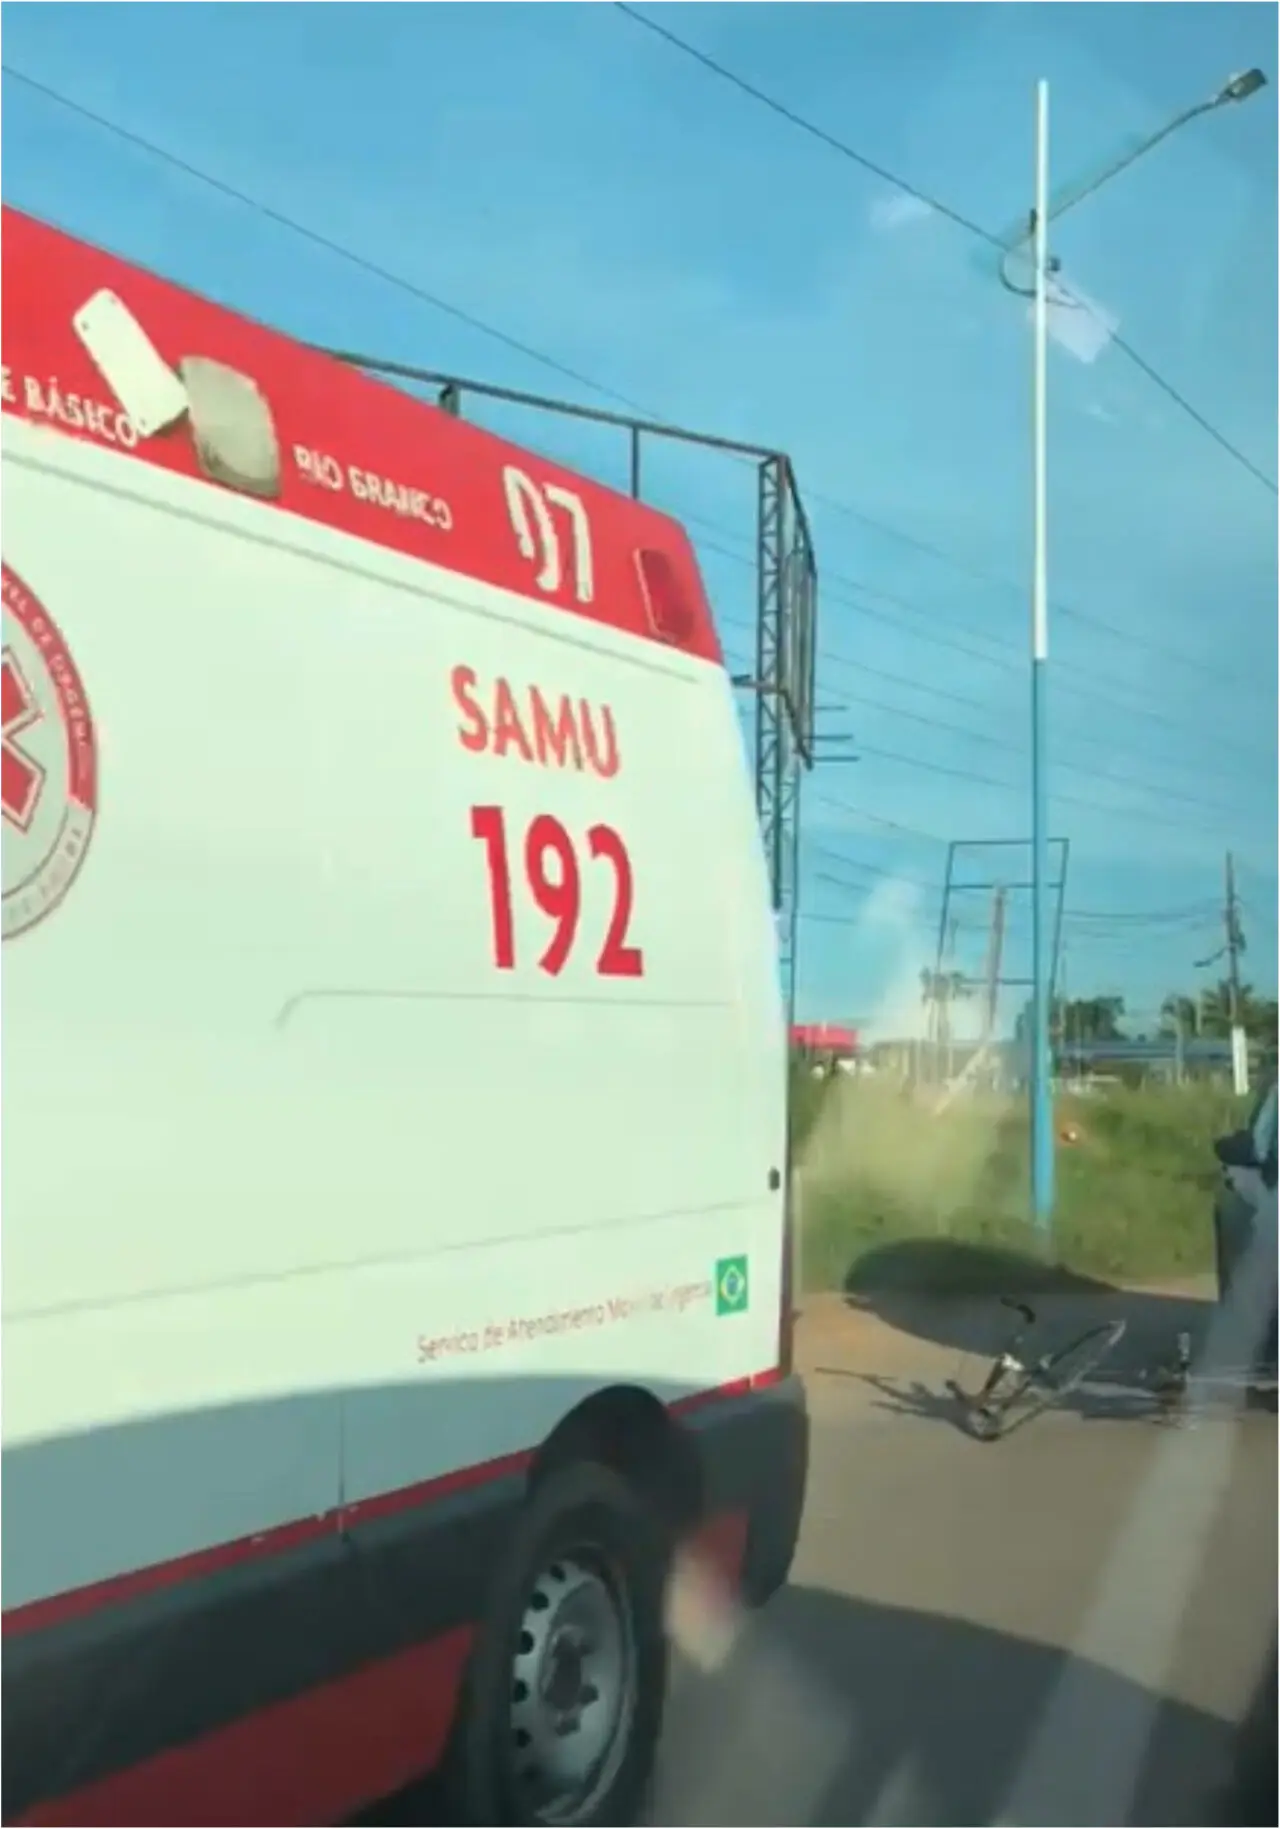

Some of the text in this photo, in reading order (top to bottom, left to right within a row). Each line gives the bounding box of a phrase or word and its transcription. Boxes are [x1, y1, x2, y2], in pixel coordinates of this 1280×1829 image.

[23, 374, 139, 450] BÁSICO
[451, 663, 621, 779] SAMU
[470, 803, 645, 979] 192
